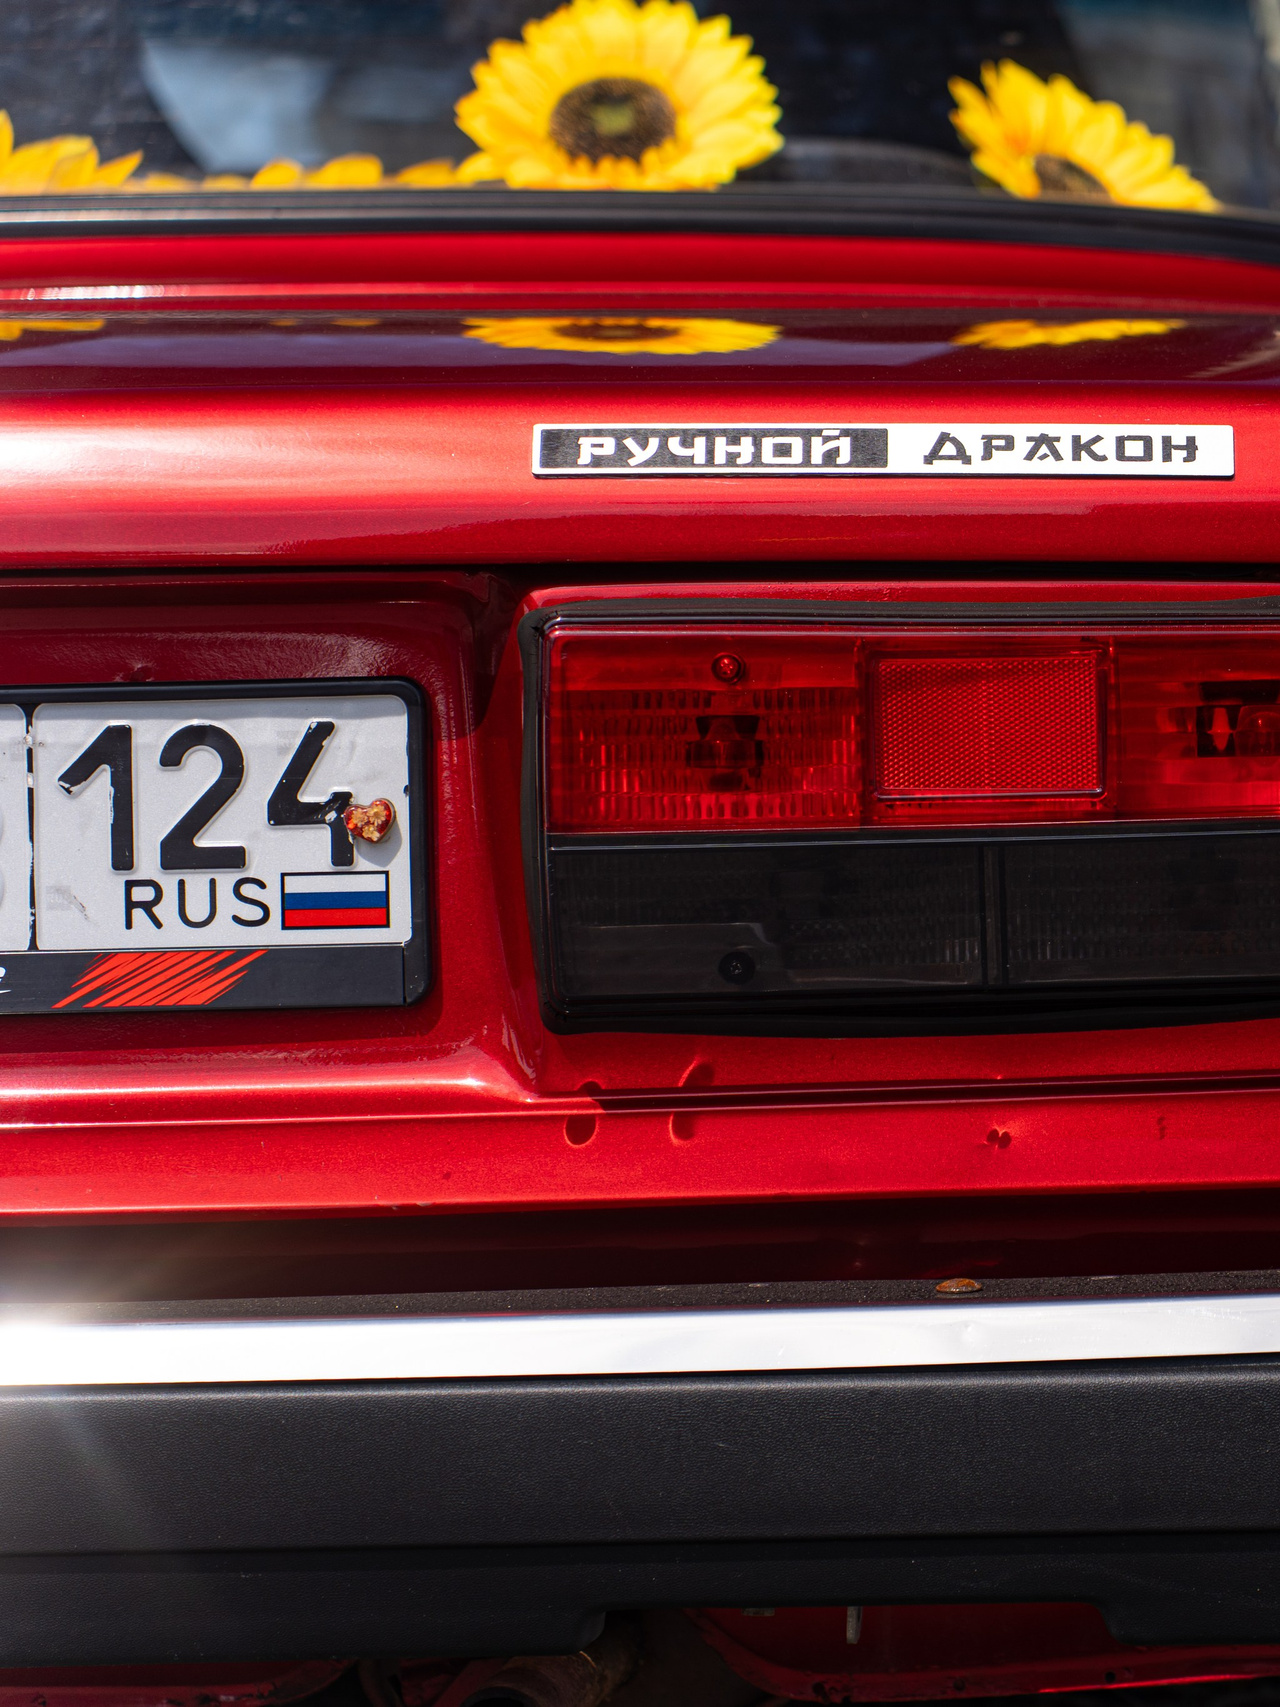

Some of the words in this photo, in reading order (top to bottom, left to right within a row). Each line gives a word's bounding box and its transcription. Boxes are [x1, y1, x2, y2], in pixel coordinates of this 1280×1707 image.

[576, 429, 852, 467] РУЧНОЙ
[922, 431, 1199, 466] ДРАКОН
[57, 720, 355, 871] 124
[124, 876, 271, 931] RUS
